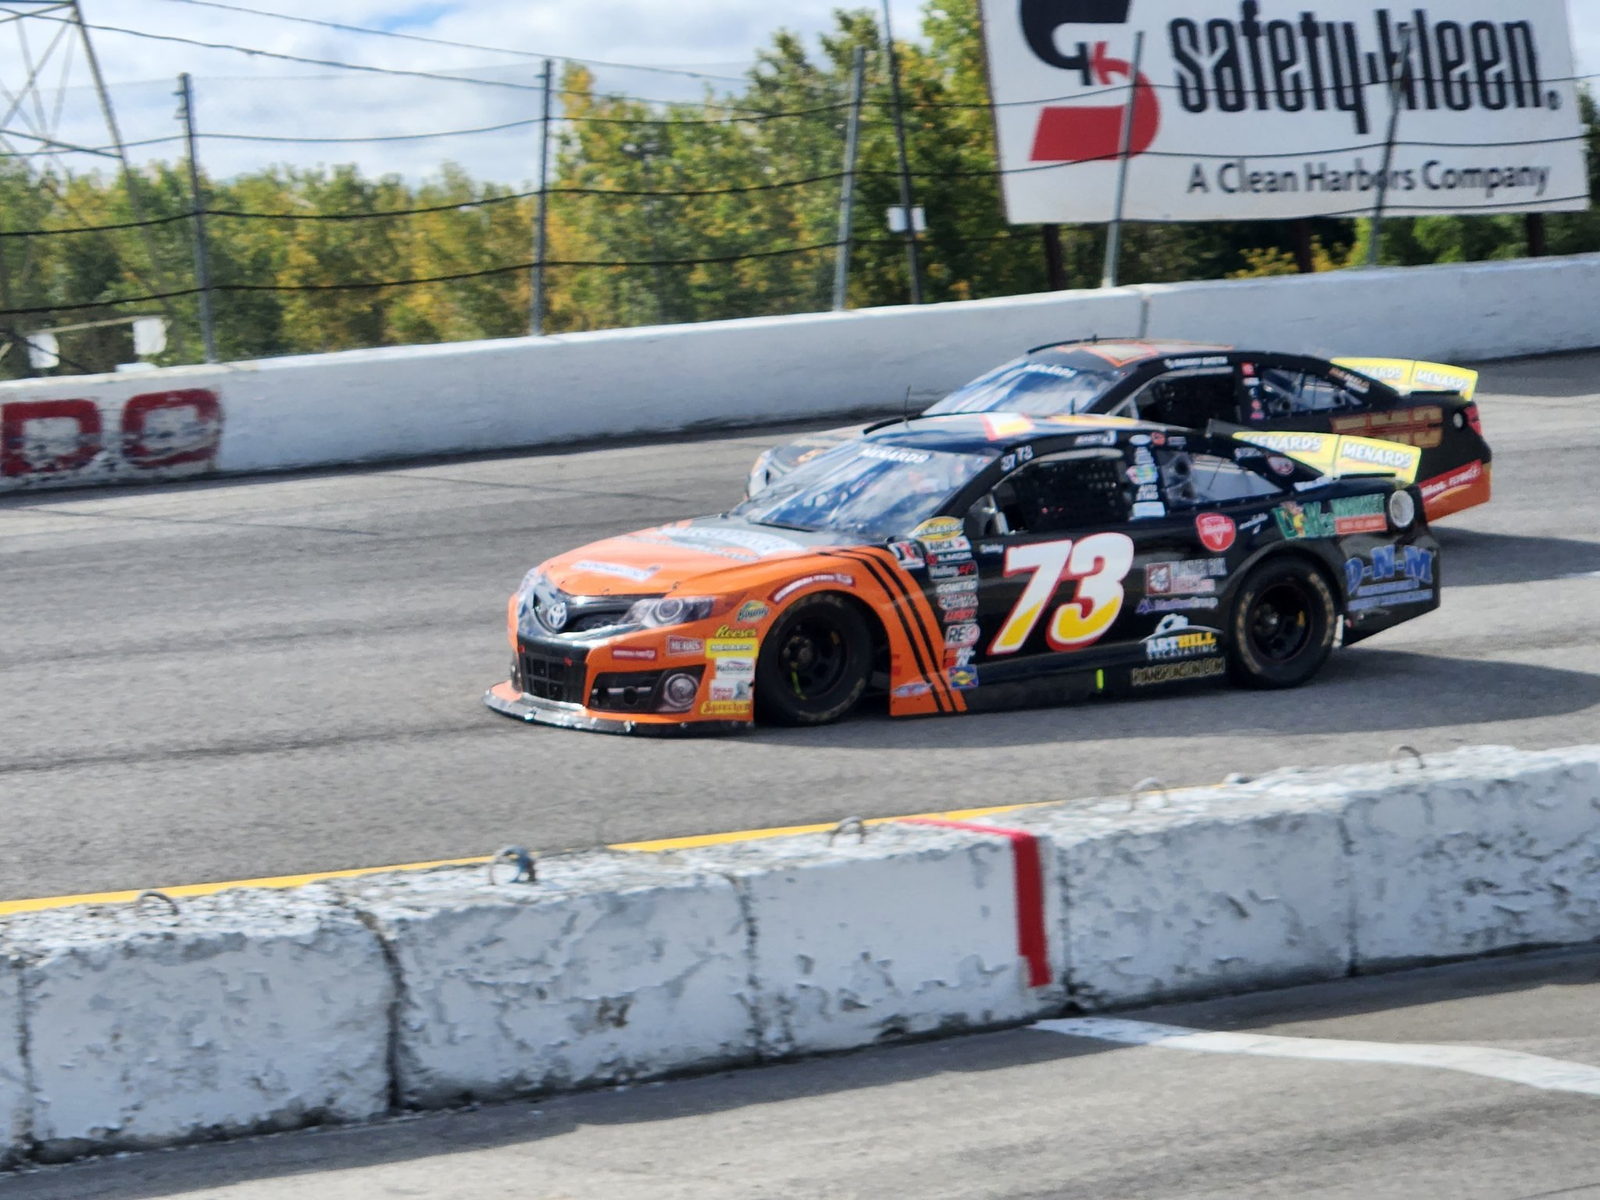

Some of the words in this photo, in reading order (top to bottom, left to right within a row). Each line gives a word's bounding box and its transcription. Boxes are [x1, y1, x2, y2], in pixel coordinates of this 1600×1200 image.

[1187, 163, 1209, 193] A
[1217, 158, 1299, 193] Clean
[1422, 160, 1551, 198] Company
[860, 447, 928, 463] MENARDS
[1340, 441, 1412, 468] MENARDS
[1345, 544, 1434, 595] D-N-M
[987, 532, 1134, 655] 73
[737, 606, 769, 622] Bounty
